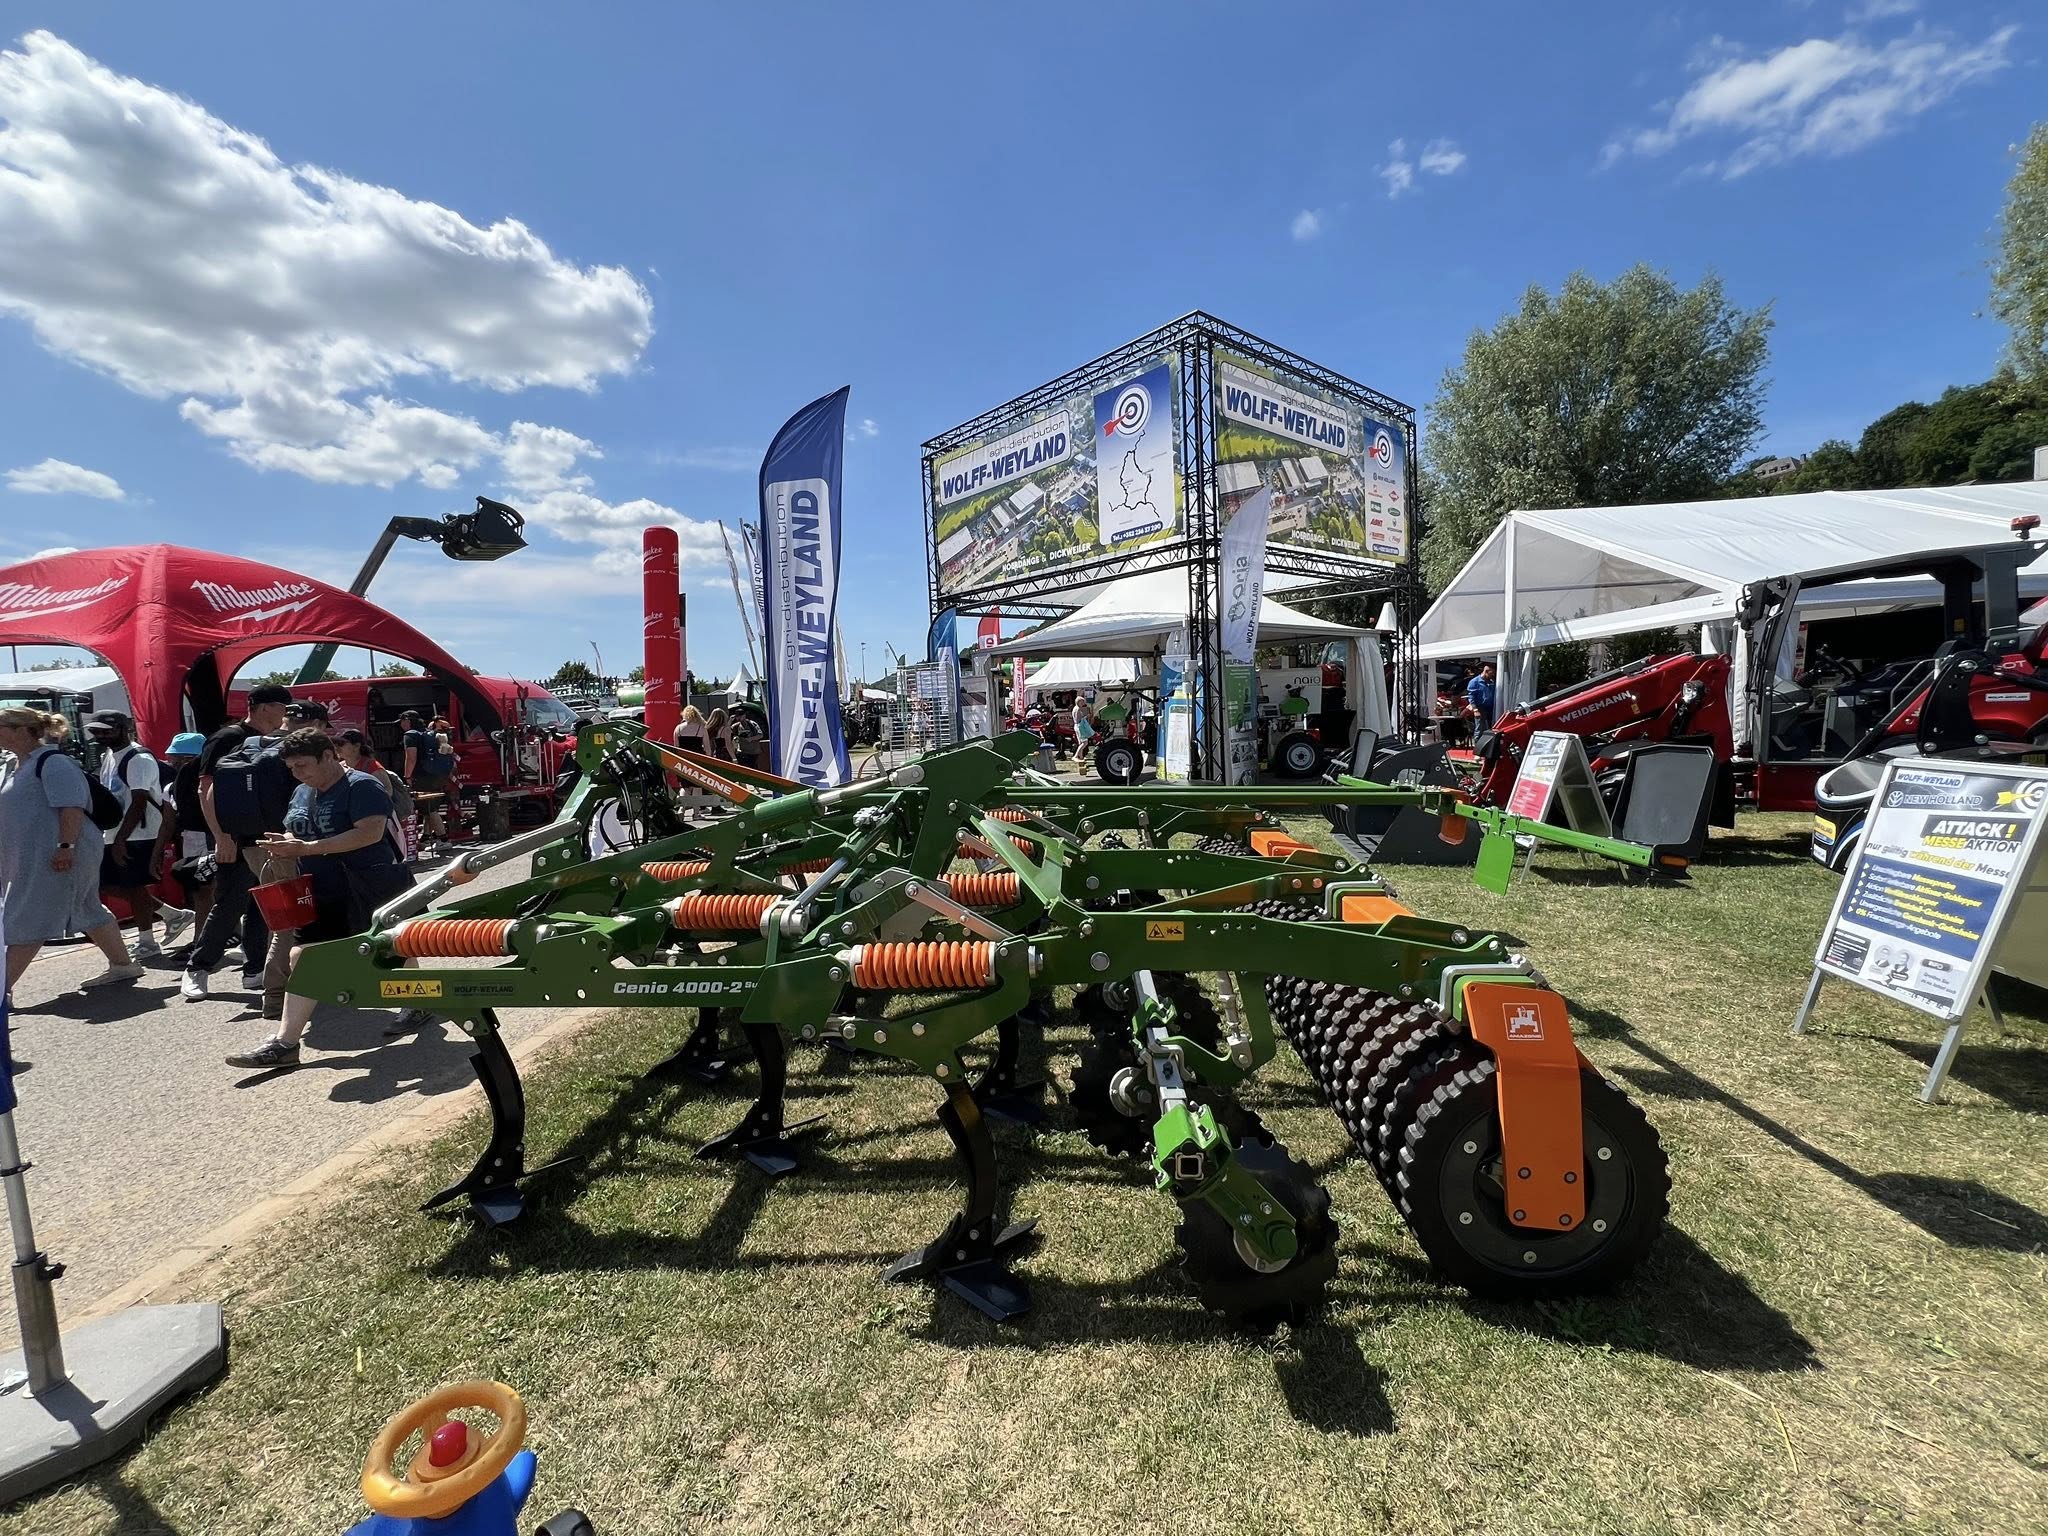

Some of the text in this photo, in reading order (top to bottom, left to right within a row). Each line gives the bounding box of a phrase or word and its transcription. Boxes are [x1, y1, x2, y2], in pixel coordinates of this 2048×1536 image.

[1226, 385, 1346, 450] WOLFF-WEYLAND
[989, 419, 1065, 458] agri-distribution
[943, 432, 1067, 500] WOLFF-WEYLAND
[1049, 543, 1092, 561] DICKWEILER
[0, 575, 130, 609] Milwaukee
[191, 579, 316, 613] Milwaukee
[775, 493, 795, 672] agri-distribution
[1246, 582, 1260, 644] WOLFF-WEYLAND
[789, 489, 829, 789] WOLFF-WEYLAND
[1558, 690, 1632, 723] WEIDEMANN
[674, 762, 733, 795] AMAZONE
[1896, 772, 1962, 787] WOLFF-WEYLAND
[1903, 794, 1983, 806] NEW HOLLAND
[1932, 820, 2006, 838] ATTACK
[1866, 843, 1882, 851] nur
[454, 985, 514, 994] WOLFF-WEYLAND
[613, 982, 669, 994] Cenio
[672, 981, 743, 994] 4000-2
